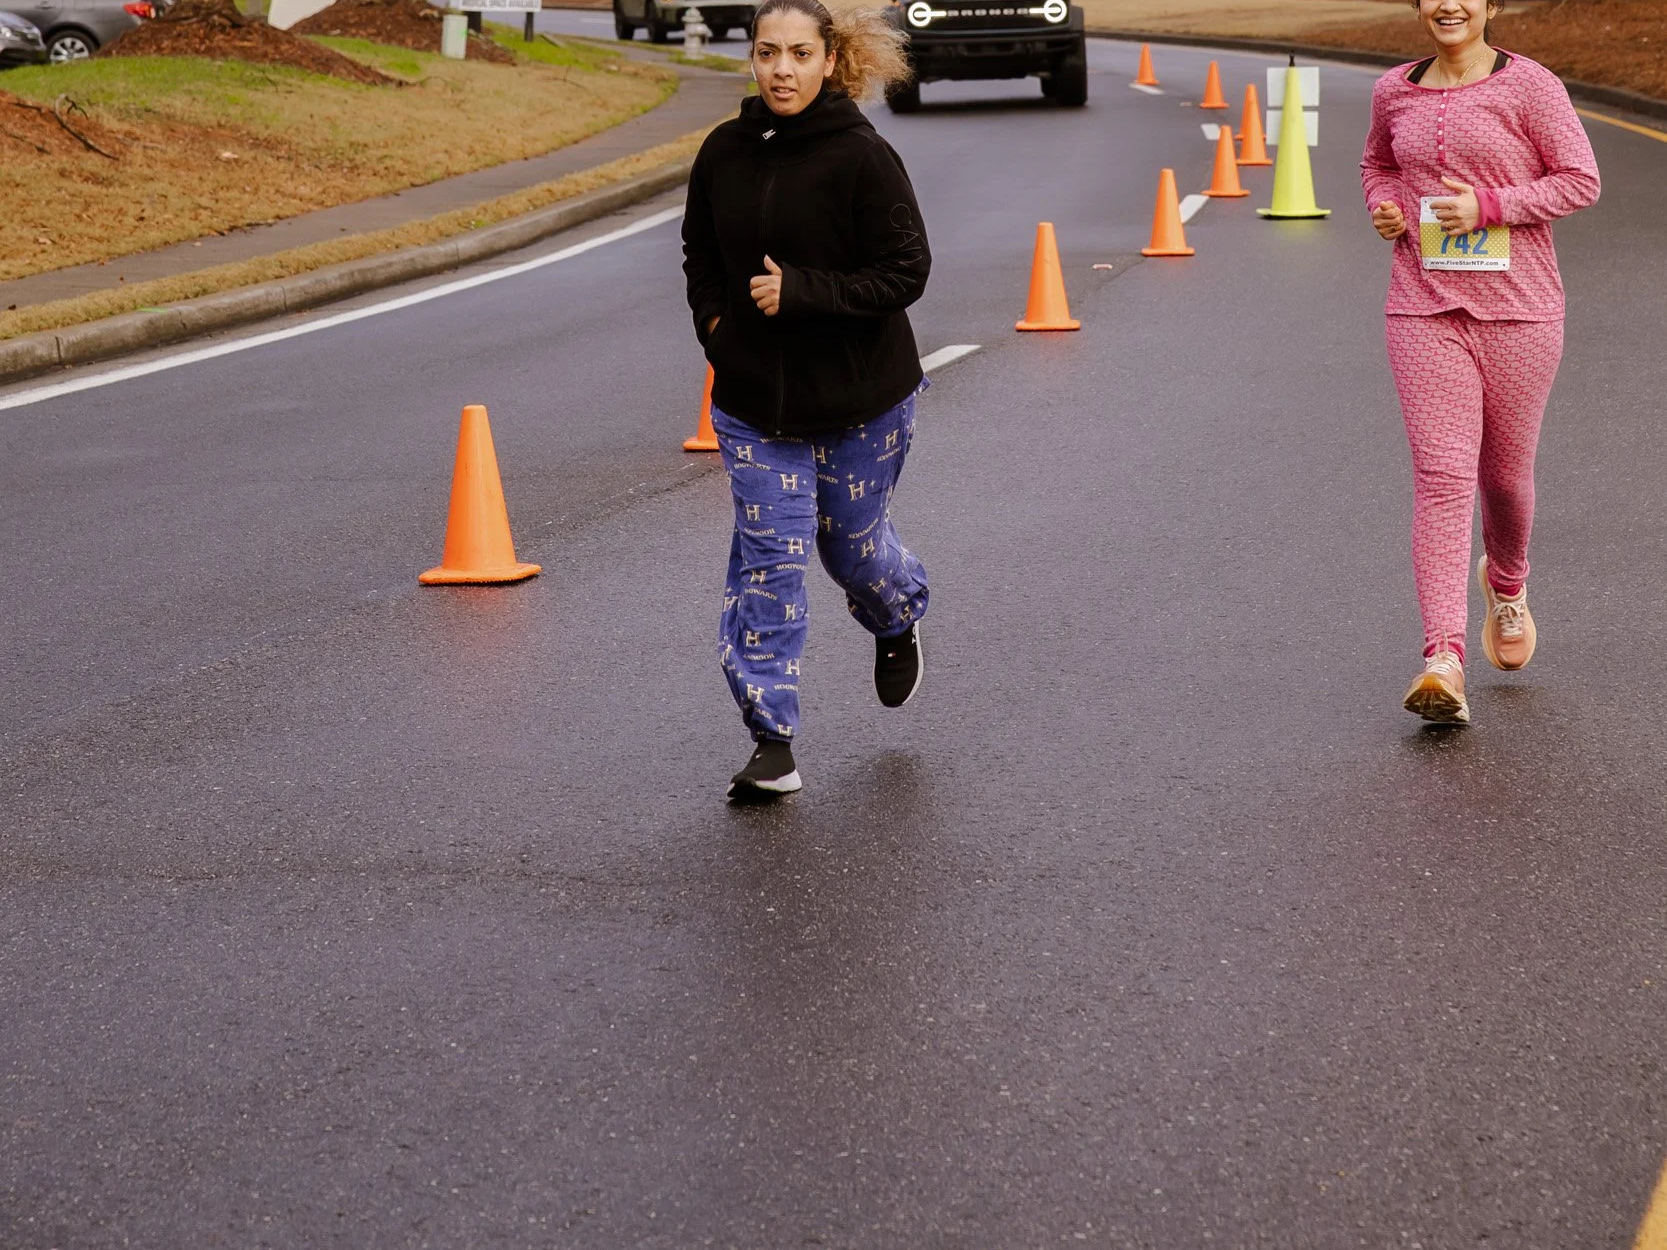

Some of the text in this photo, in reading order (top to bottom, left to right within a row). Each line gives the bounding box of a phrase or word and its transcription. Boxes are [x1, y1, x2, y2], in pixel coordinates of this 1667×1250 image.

[1440, 226, 1489, 255] 742
[736, 445, 753, 462] H
[780, 473, 799, 491] H
[848, 480, 866, 501] H
[745, 504, 761, 522] H
[787, 538, 805, 555] H
[750, 570, 768, 585] H
[745, 630, 762, 647] H
[746, 683, 765, 703] H
